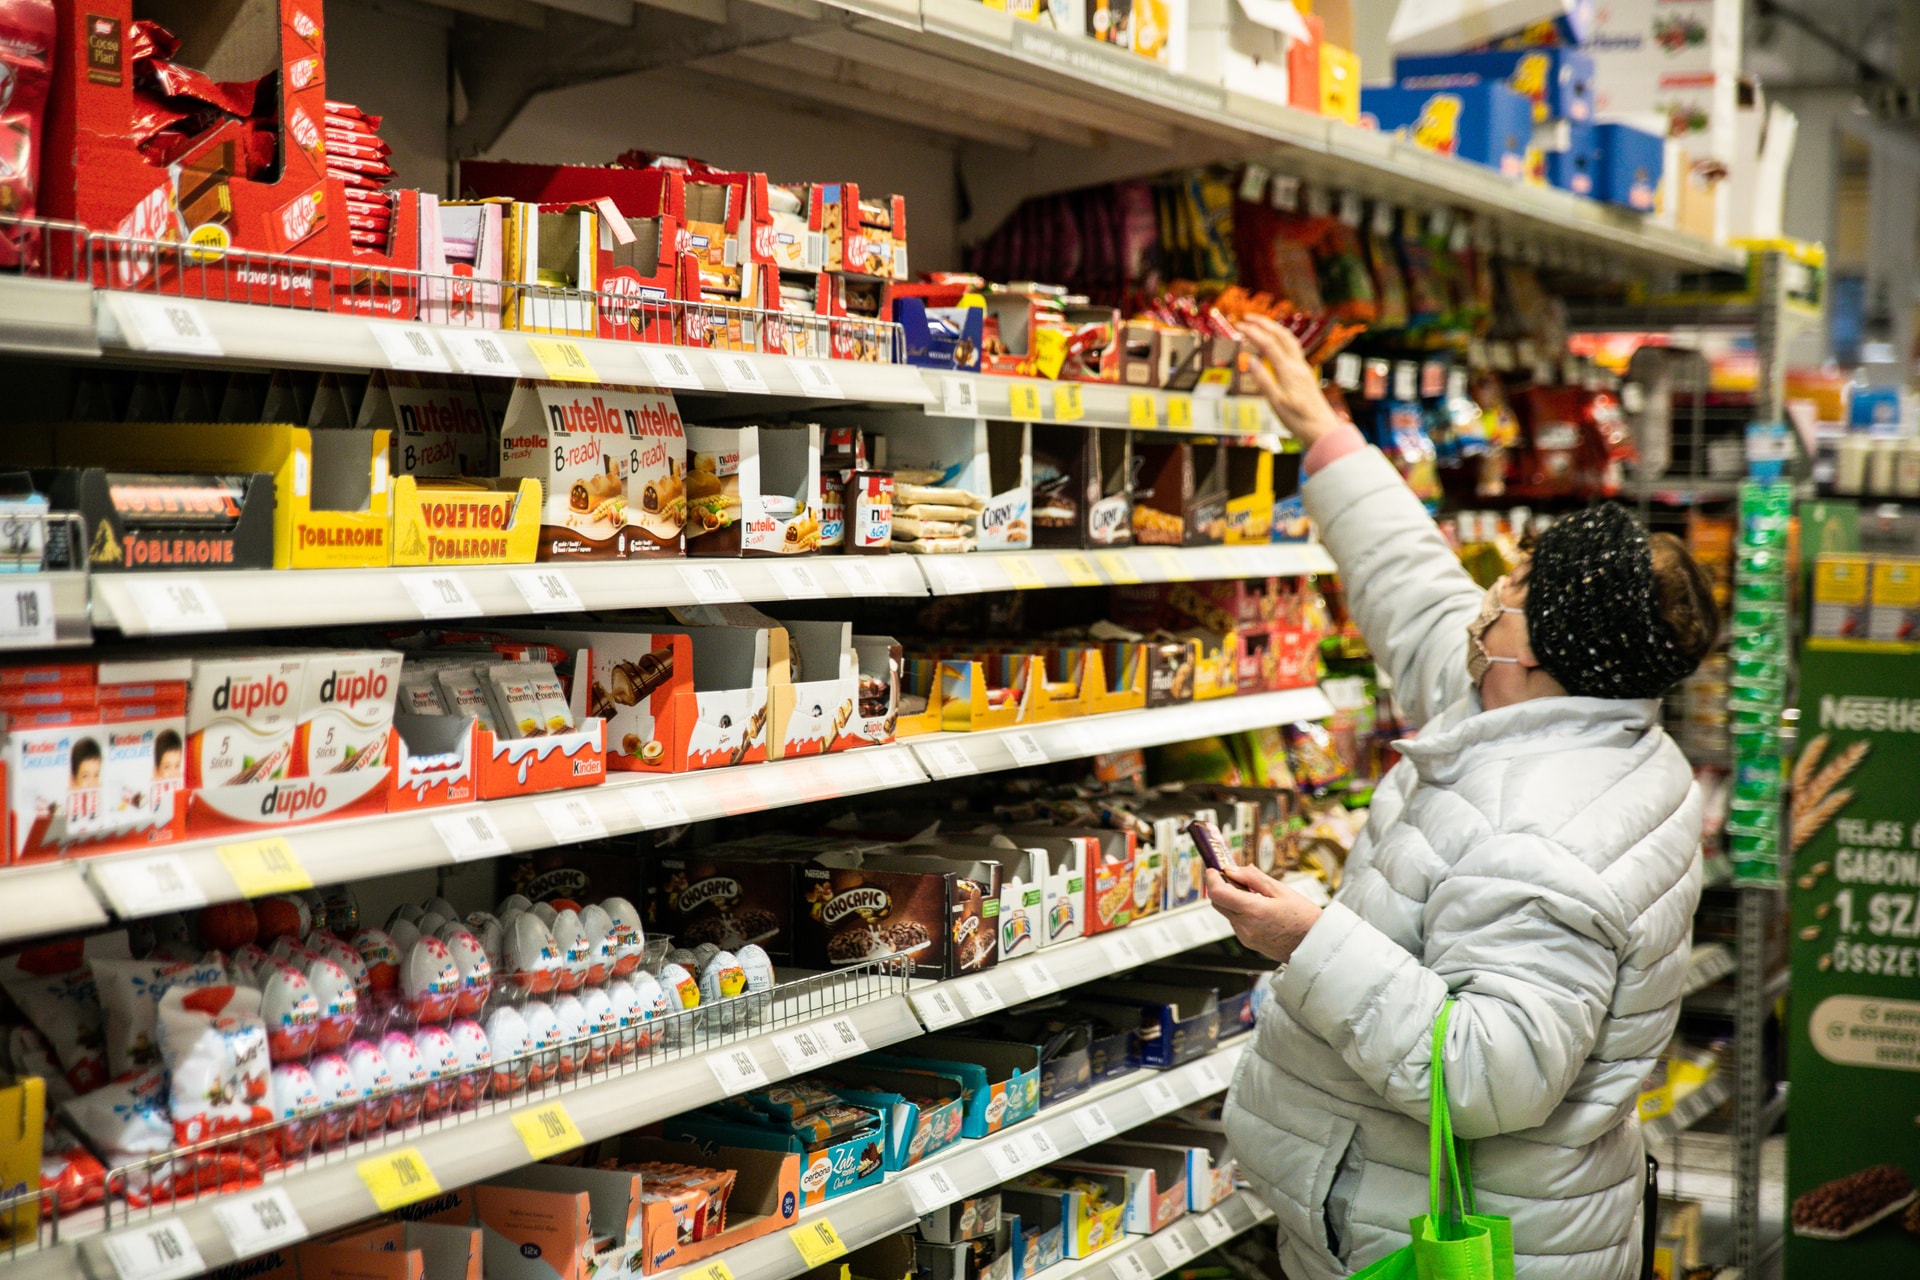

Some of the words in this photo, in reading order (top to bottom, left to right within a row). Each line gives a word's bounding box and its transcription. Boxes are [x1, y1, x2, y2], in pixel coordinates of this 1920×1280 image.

[89, 35, 118, 52] Cocoa
[95, 51, 116, 65] Plan
[194, 233, 222, 251] mini
[237, 265, 266, 284] Have
[404, 331, 433, 356] 189
[475, 338, 503, 363] 369
[560, 343, 585, 369] 249
[664, 352, 689, 377] 189
[400, 398, 483, 434] nutella
[548, 396, 624, 434] nutella
[624, 402, 684, 438] nutella
[503, 434, 548, 450] nutella
[554, 435, 601, 472] B-ready
[404, 438, 457, 471] B-ready
[503, 450, 532, 461] B-ready
[630, 439, 667, 474] B-ready
[746, 517, 775, 533] nutella
[983, 503, 1013, 529] CORNY
[298, 524, 384, 548] TOBLERONE
[123, 536, 235, 568] TOBLERONE
[428, 535, 507, 562] TOBLERONE
[433, 579, 462, 603] 229
[538, 575, 568, 599] 549
[212, 674, 288, 718] duplo
[320, 668, 387, 709] duplo
[506, 693, 535, 704] Country
[535, 690, 563, 701] Country
[457, 696, 485, 706] Country
[325, 727, 335, 745] 5
[864, 721, 883, 734] duplo
[221, 736, 230, 755] 5
[261, 782, 327, 819] duplo
[1836, 818, 1903, 847] TELJES
[680, 879, 736, 909] CHOCAPIC
[825, 889, 882, 921] CHOCAPIC
[834, 1020, 855, 1043] 359
[797, 1033, 817, 1056] 359
[732, 1052, 757, 1076] 359
[538, 1110, 565, 1138] 209
[833, 1148, 854, 1175] Zab
[393, 1162, 421, 1188] 209
[803, 1165, 831, 1184] cerbona
[815, 1222, 835, 1246] 115
[524, 1246, 538, 1255] 12x
